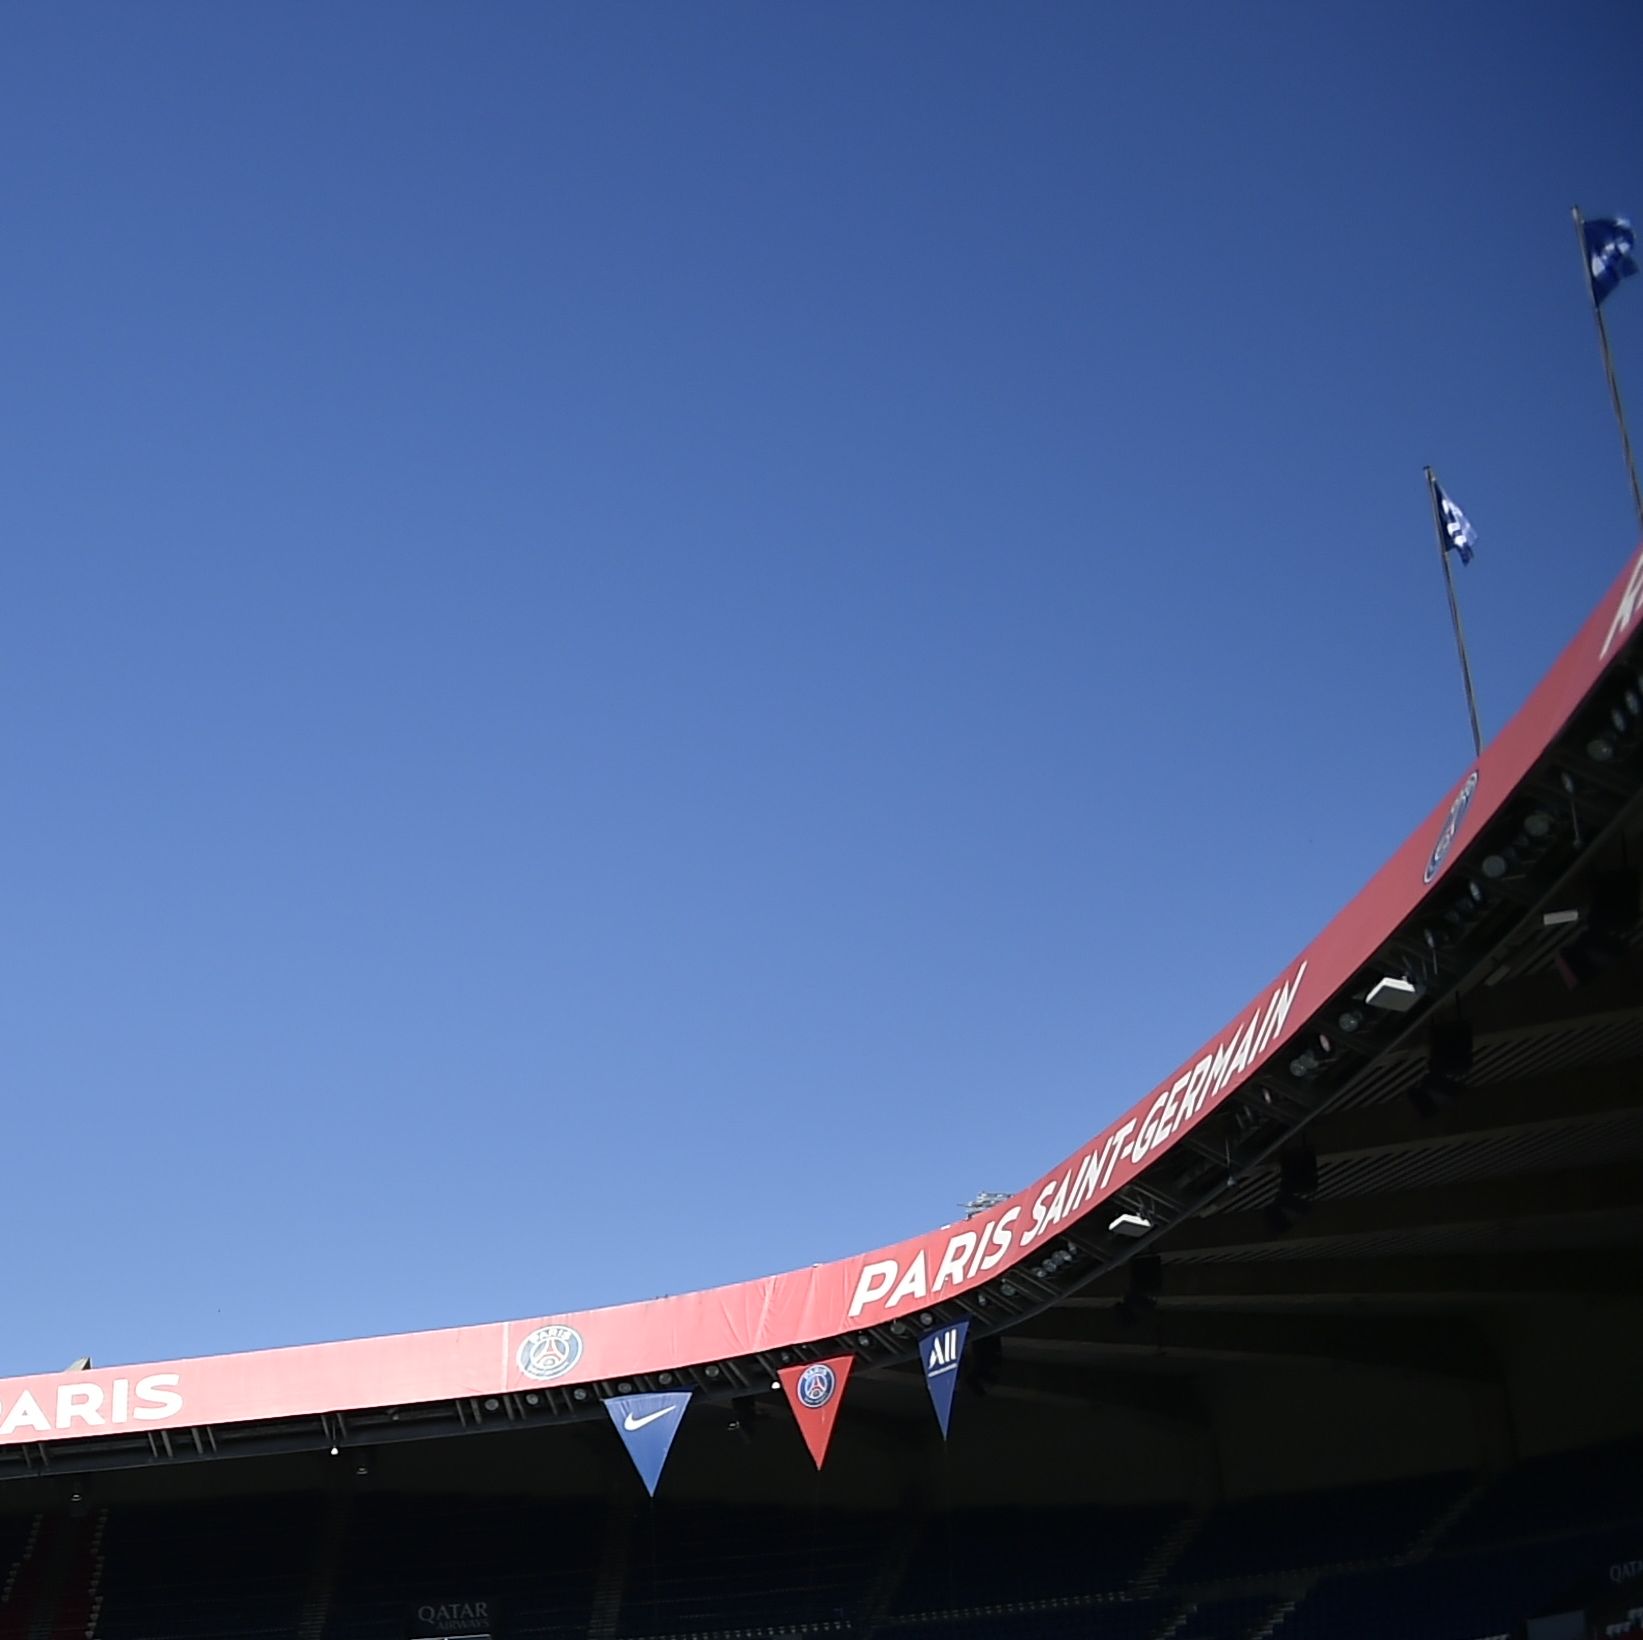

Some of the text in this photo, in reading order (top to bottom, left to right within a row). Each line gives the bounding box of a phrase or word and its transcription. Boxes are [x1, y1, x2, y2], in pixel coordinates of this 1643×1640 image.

[847, 959, 1307, 1318] PARIS SAINT-GERMAIN
[418, 1602, 488, 1625] QATAR
[436, 1618, 490, 1631] AIRWAYS
